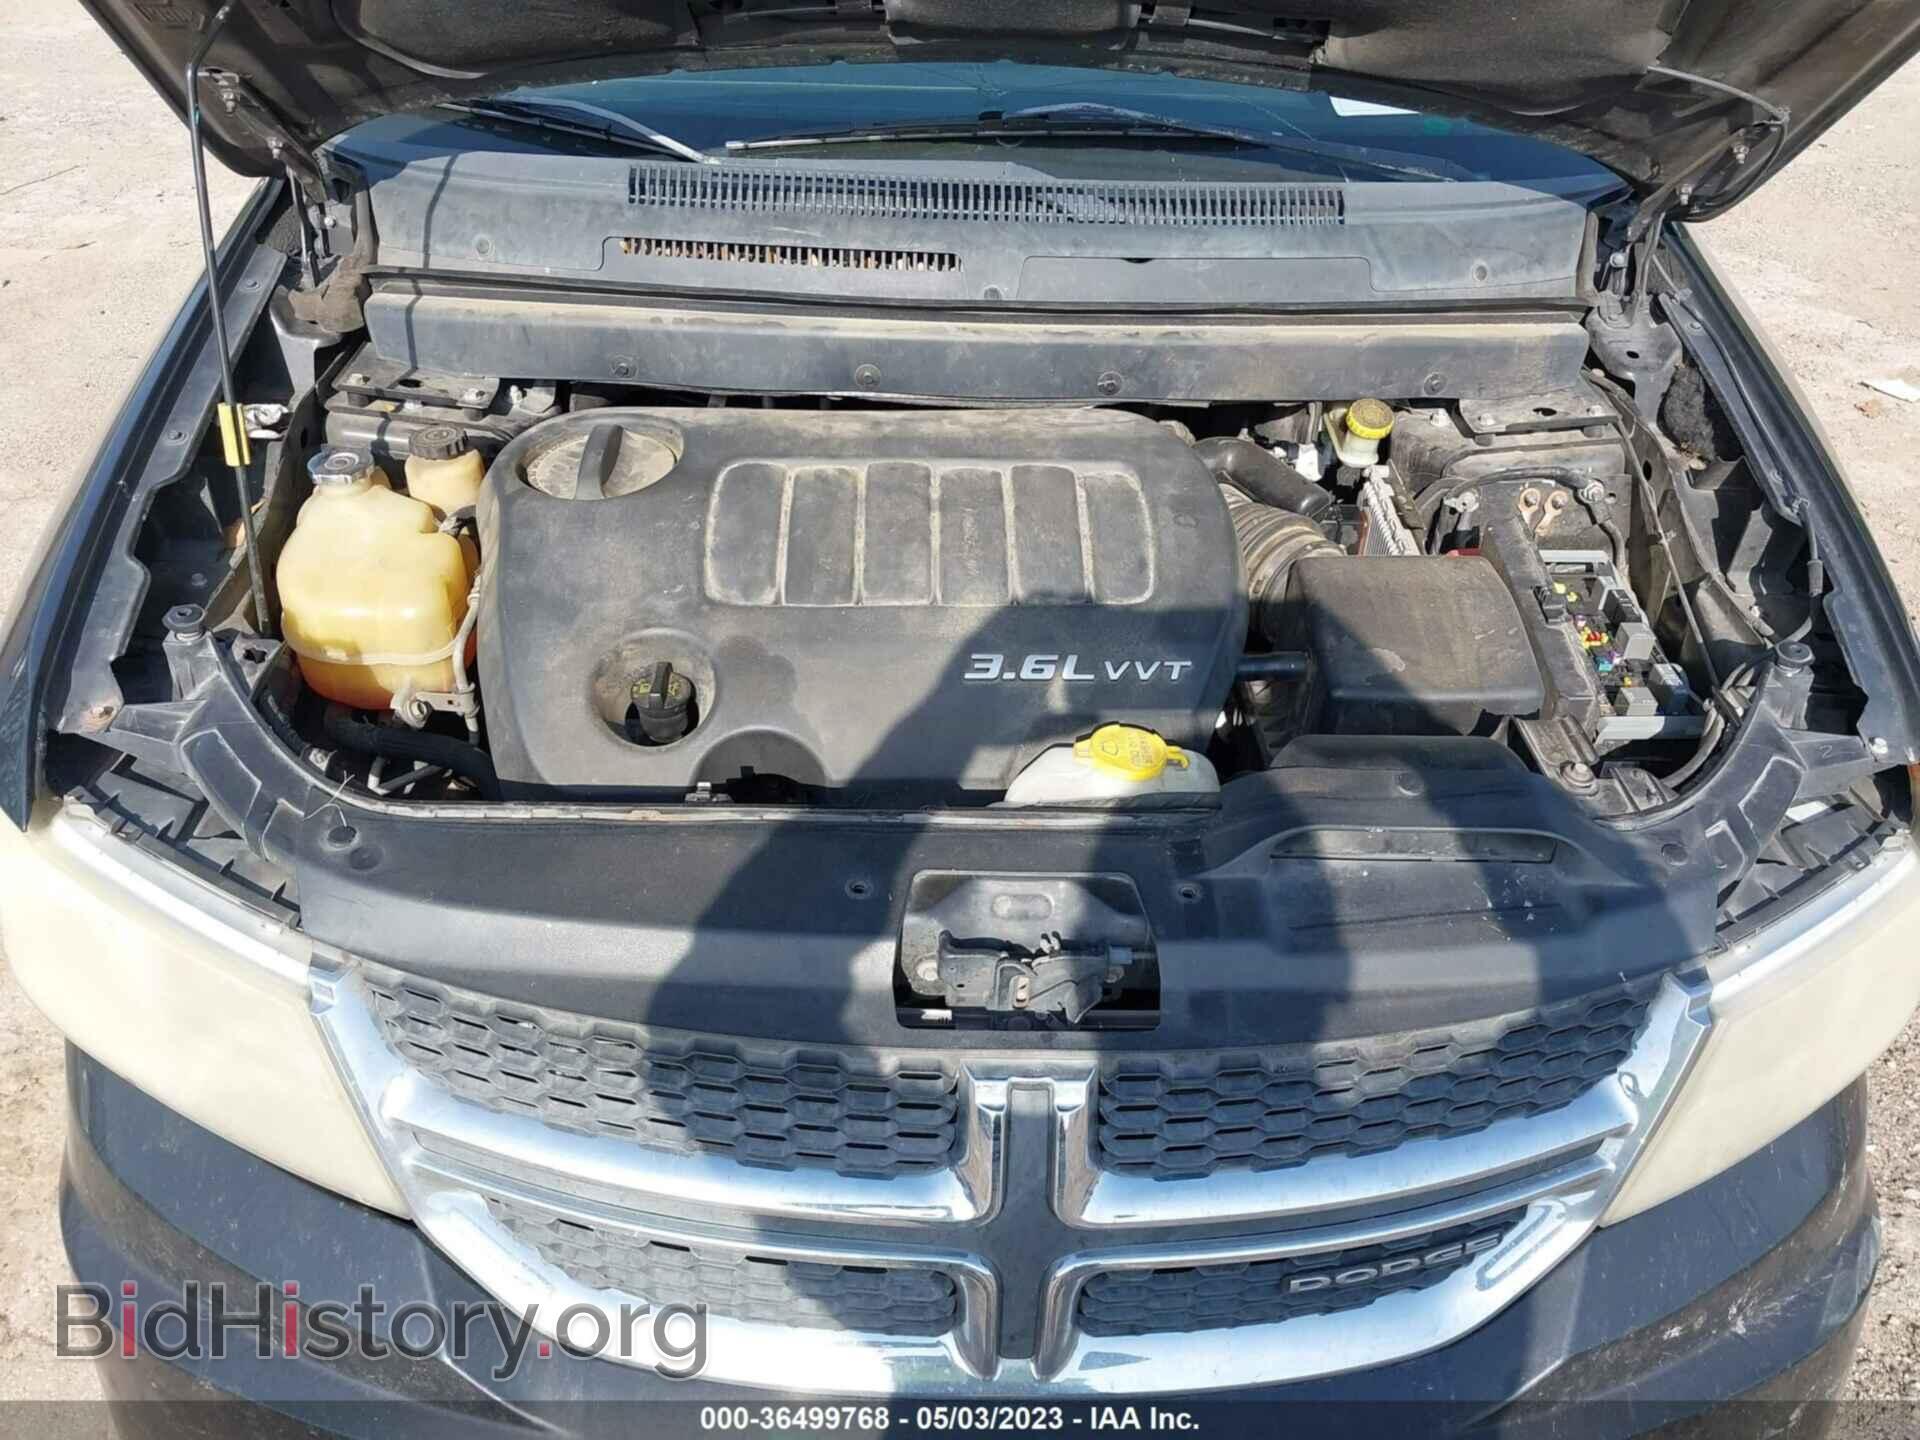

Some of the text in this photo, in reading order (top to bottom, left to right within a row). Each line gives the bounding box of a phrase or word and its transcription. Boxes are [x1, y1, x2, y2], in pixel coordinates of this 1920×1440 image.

[964, 653, 1193, 682] 3.6L VVT
[1289, 1231, 1503, 1294] DODGE
